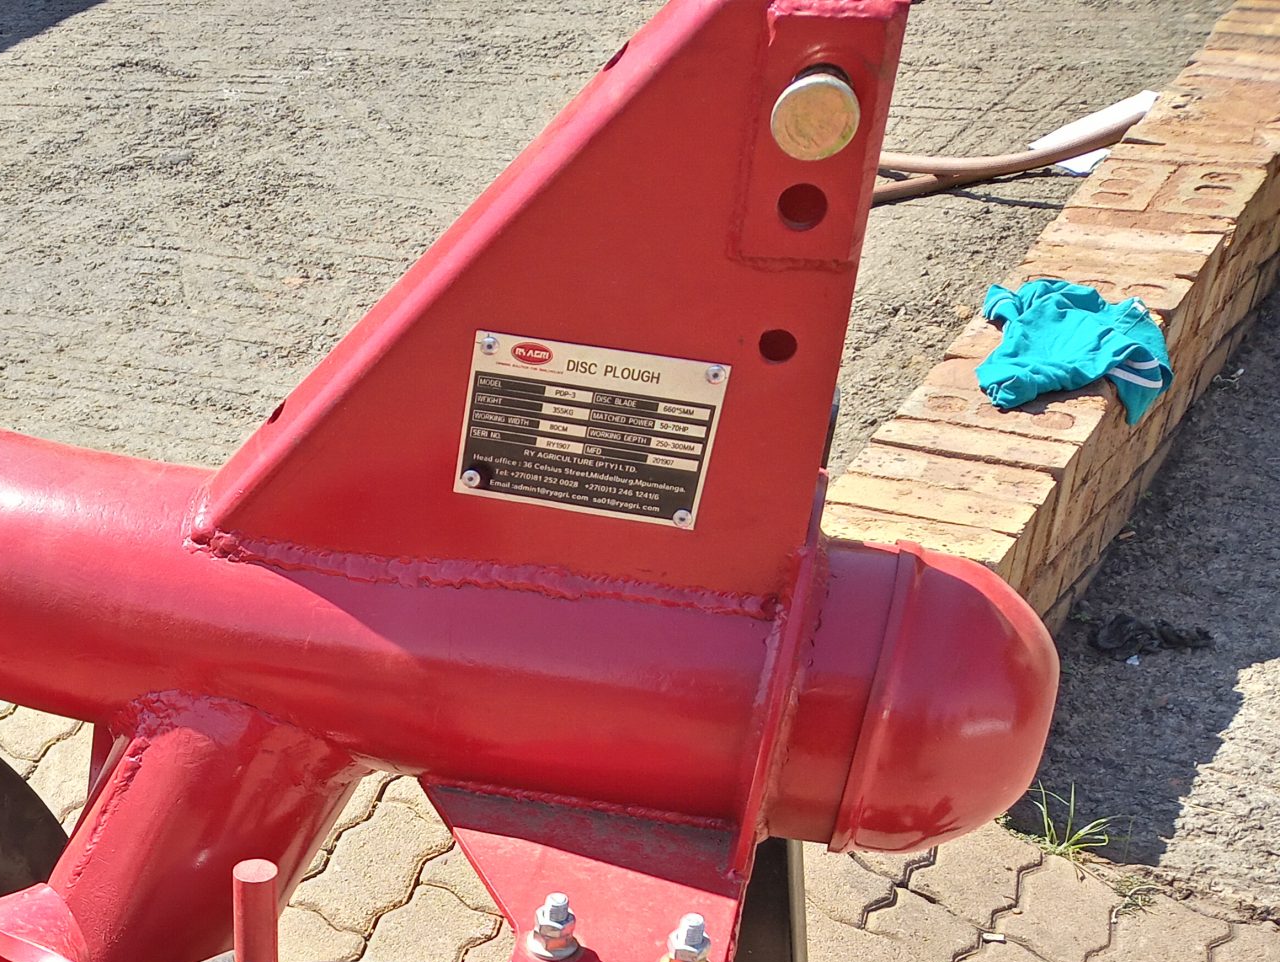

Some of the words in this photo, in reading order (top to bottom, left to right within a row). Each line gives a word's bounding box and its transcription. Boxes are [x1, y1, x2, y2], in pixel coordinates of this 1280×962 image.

[566, 359, 598, 375] DISC
[604, 365, 661, 384] PLOUGH
[479, 378, 501, 387] MODEL
[477, 396, 502, 404] WEIGHT
[596, 395, 612, 404] DISC
[614, 398, 637, 407] BLADE
[474, 413, 505, 423] WORKING
[508, 418, 529, 426] WIDTH
[593, 412, 626, 423] MATCHED
[629, 418, 654, 427] POWER
[590, 430, 621, 439] WORKING
[624, 435, 647, 444] DEPTH
[473, 454, 493, 462] Head
[495, 457, 517, 466] office
[534, 464, 562, 473] Celsius
[537, 452, 594, 467] AGRICULTURE
[489, 480, 510, 488] Email
[544, 476, 557, 484] 252
[559, 480, 579, 488] 0028
[585, 484, 616, 494] +27(0)13
[618, 488, 633, 496] 246
[636, 491, 659, 500] 1241/6
